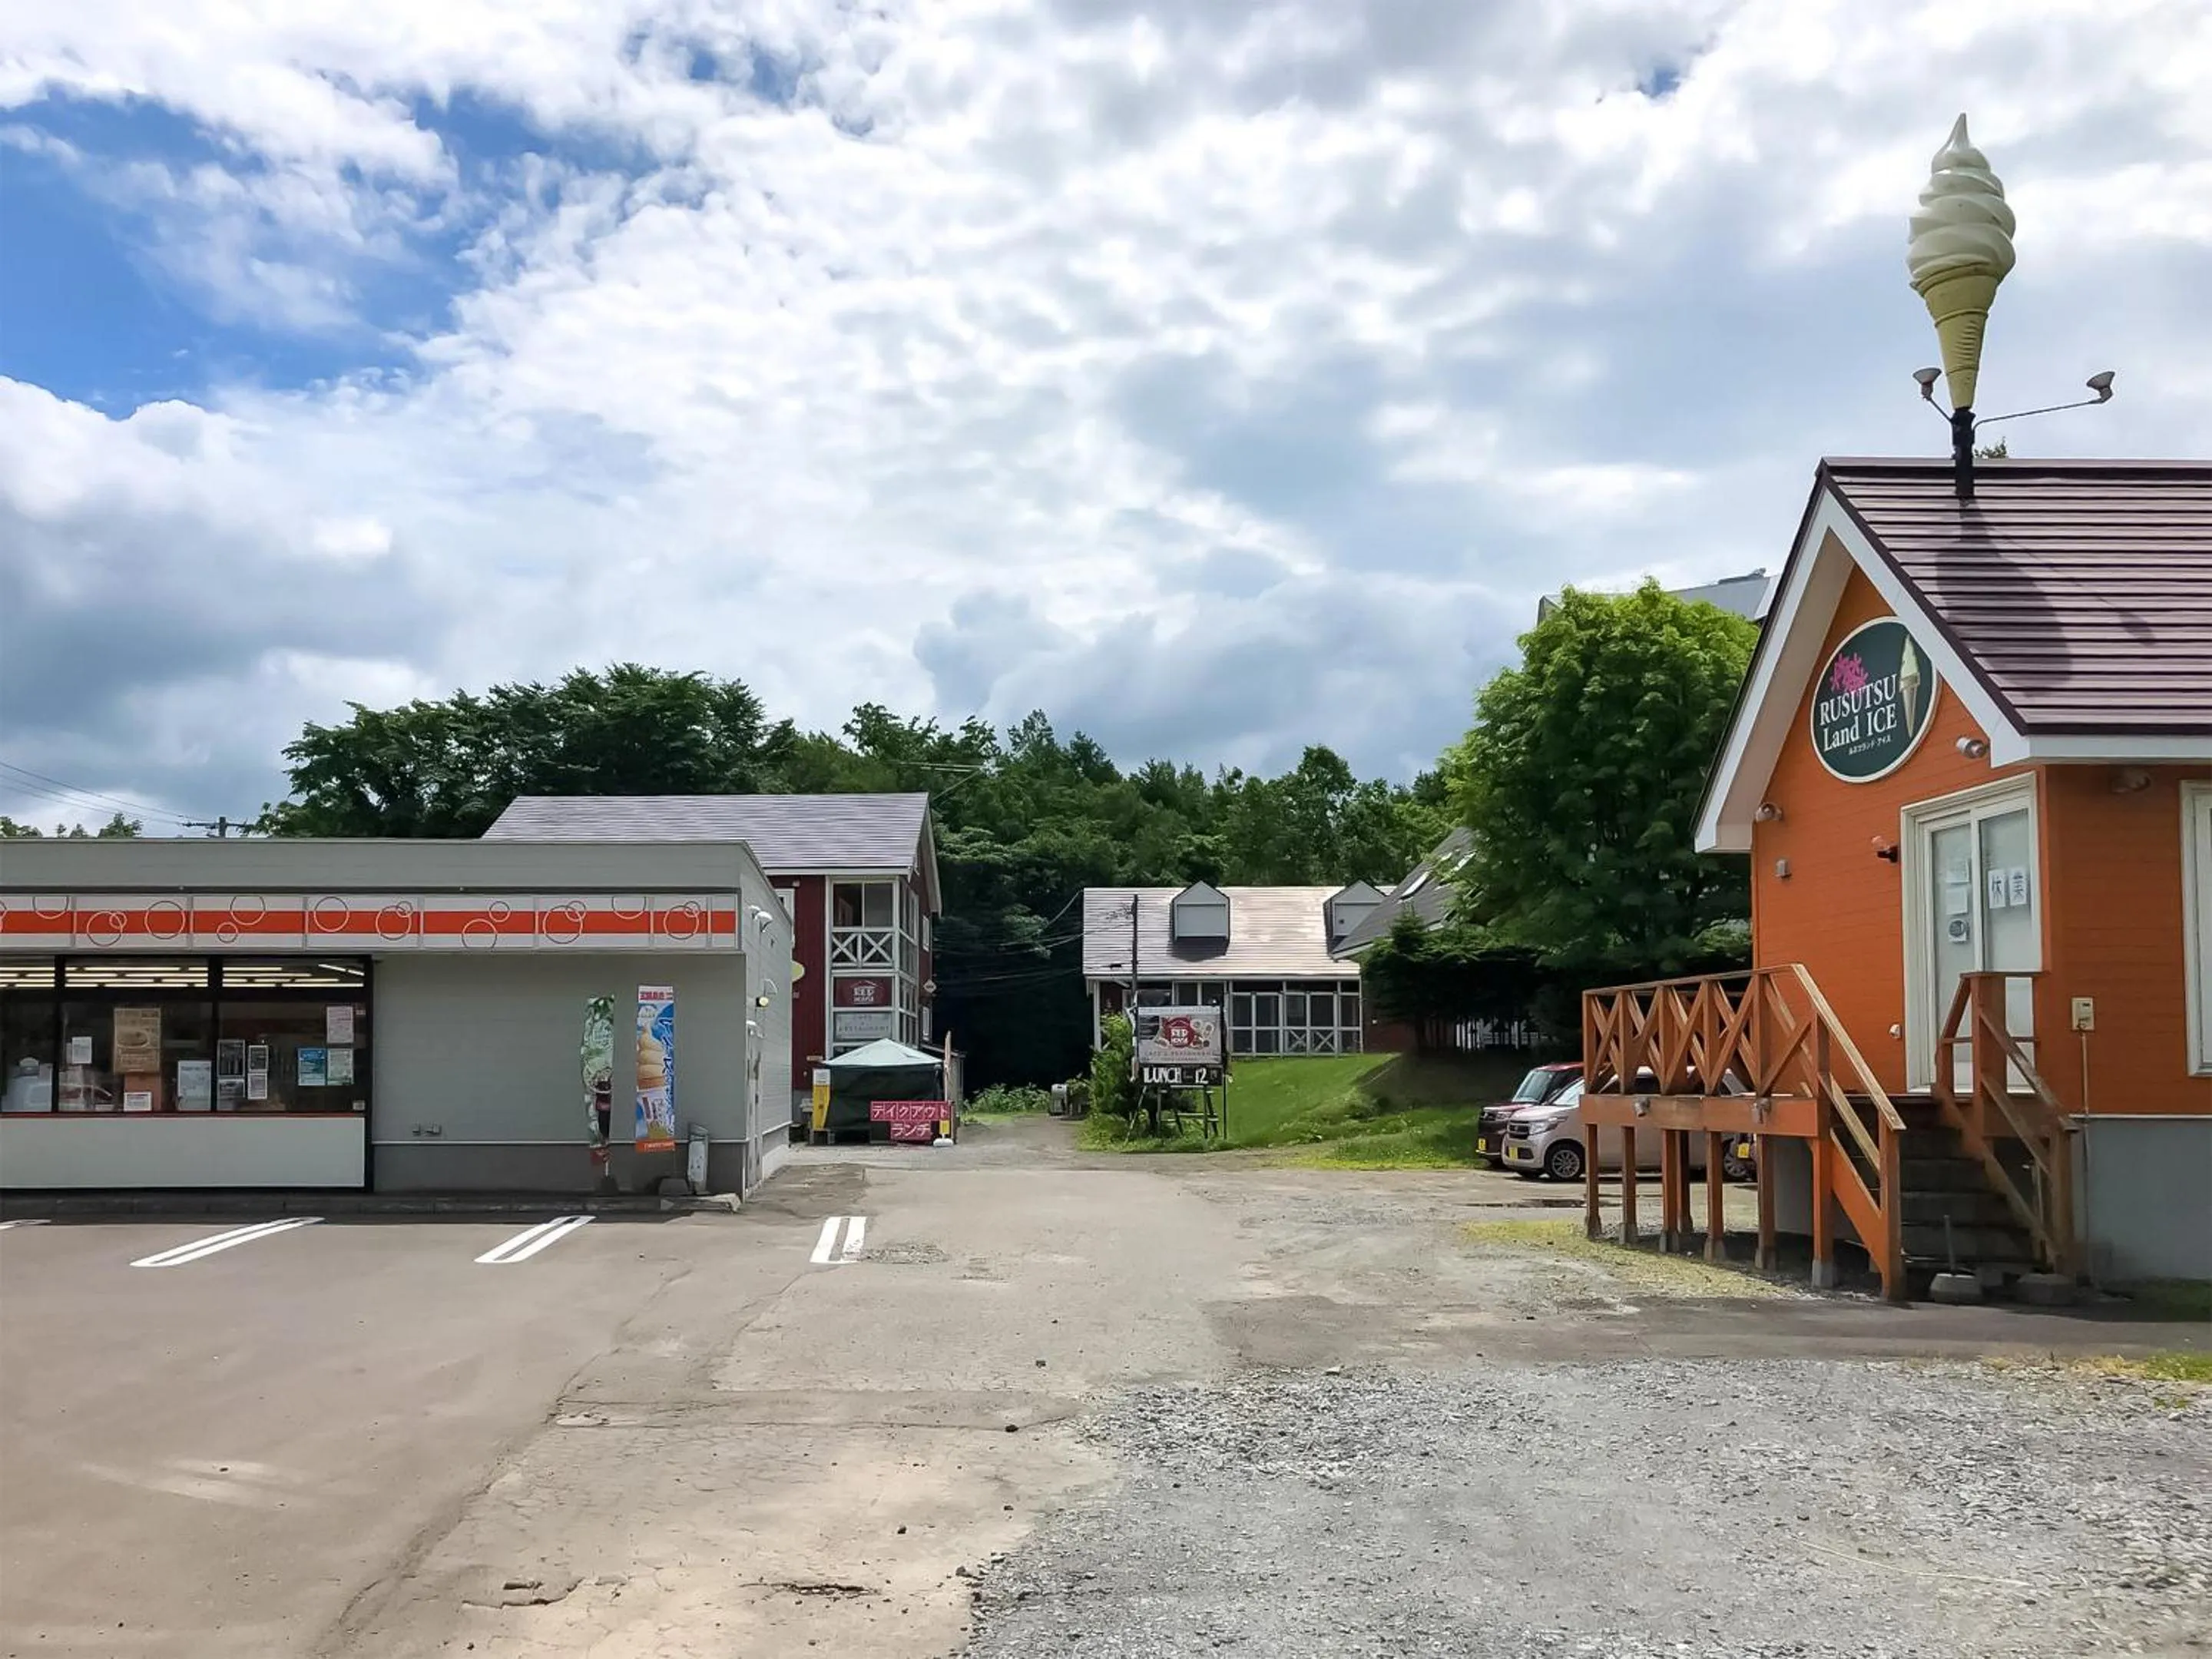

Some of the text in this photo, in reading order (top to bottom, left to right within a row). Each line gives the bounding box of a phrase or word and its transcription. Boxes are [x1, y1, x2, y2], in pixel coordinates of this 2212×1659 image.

[1820, 674, 1897, 726] RUSUTSU
[1823, 704, 1897, 752] Land ICE
[873, 1105, 948, 1118] テイクアウト
[891, 1123, 931, 1137] ランチ
